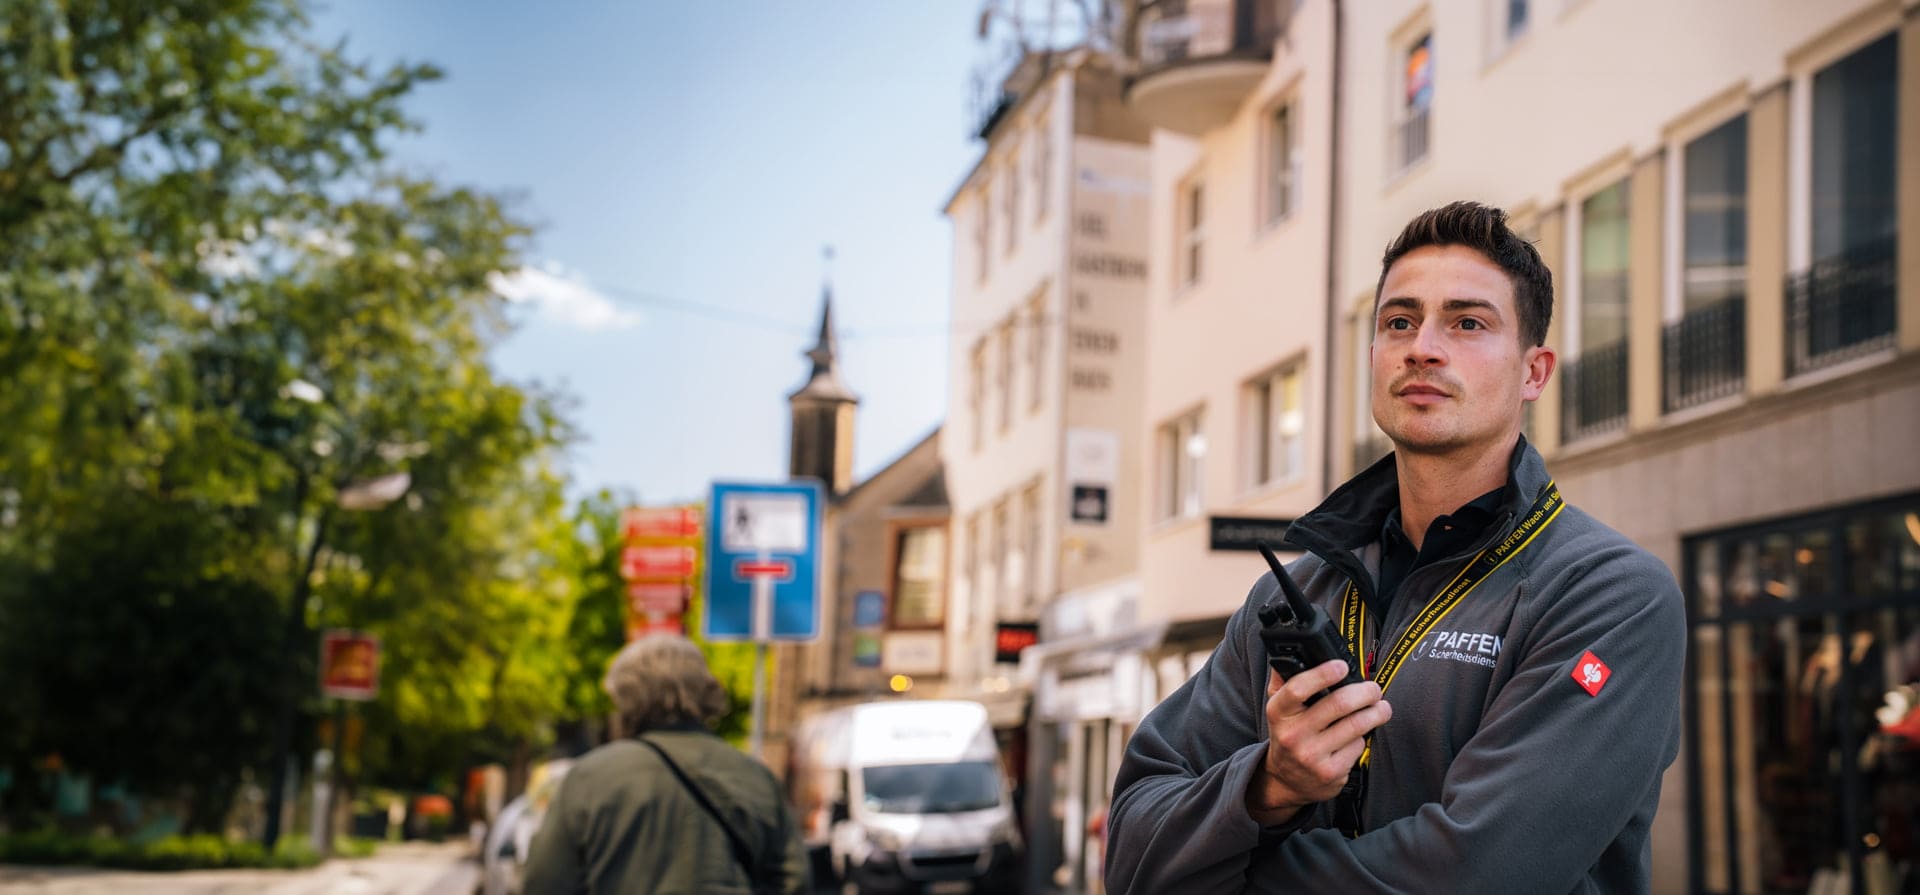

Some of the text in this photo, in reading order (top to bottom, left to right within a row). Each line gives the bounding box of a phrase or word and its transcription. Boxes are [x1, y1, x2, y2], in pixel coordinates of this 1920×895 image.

[1495, 526, 1526, 556] PAFFEN
[1521, 509, 1545, 530] Wach-
[1542, 497, 1555, 511] und
[1378, 578, 1472, 684] Wach- und Sicherheitsdienst
[1433, 630, 1505, 657] PAFFEN
[1428, 648, 1498, 669] Sicherheitsdiens
